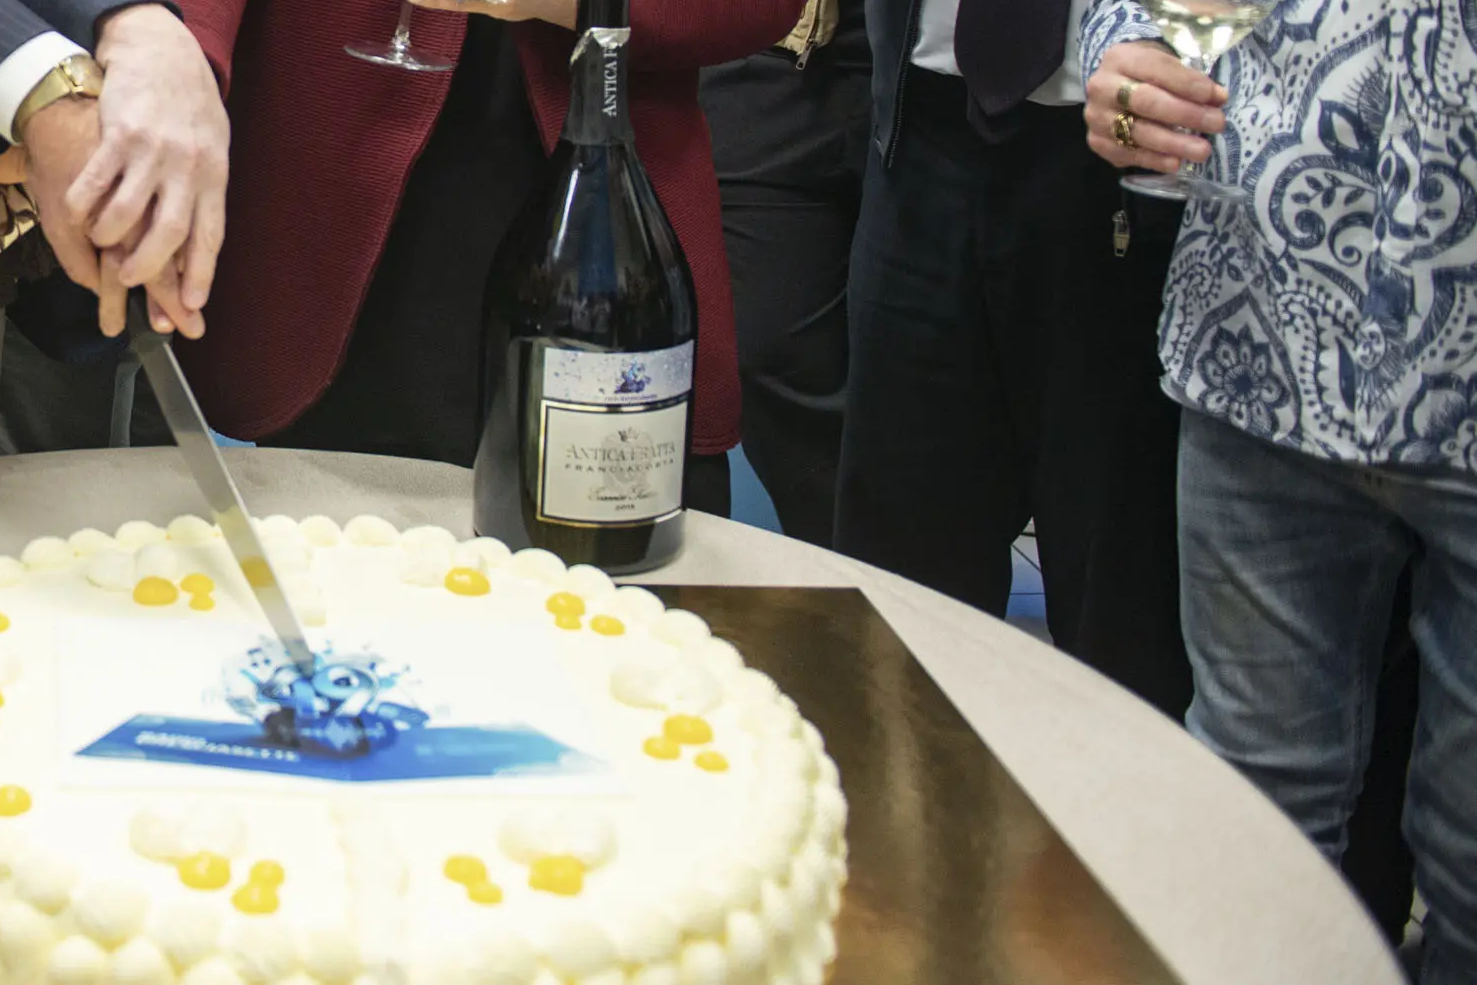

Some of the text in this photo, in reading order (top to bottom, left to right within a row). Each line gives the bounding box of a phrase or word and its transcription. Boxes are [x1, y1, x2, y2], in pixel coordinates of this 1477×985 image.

[602, 60, 618, 118] ANTICA
[566, 443, 626, 462] ANTICA
[565, 458, 674, 473] FRANCIACORTA
